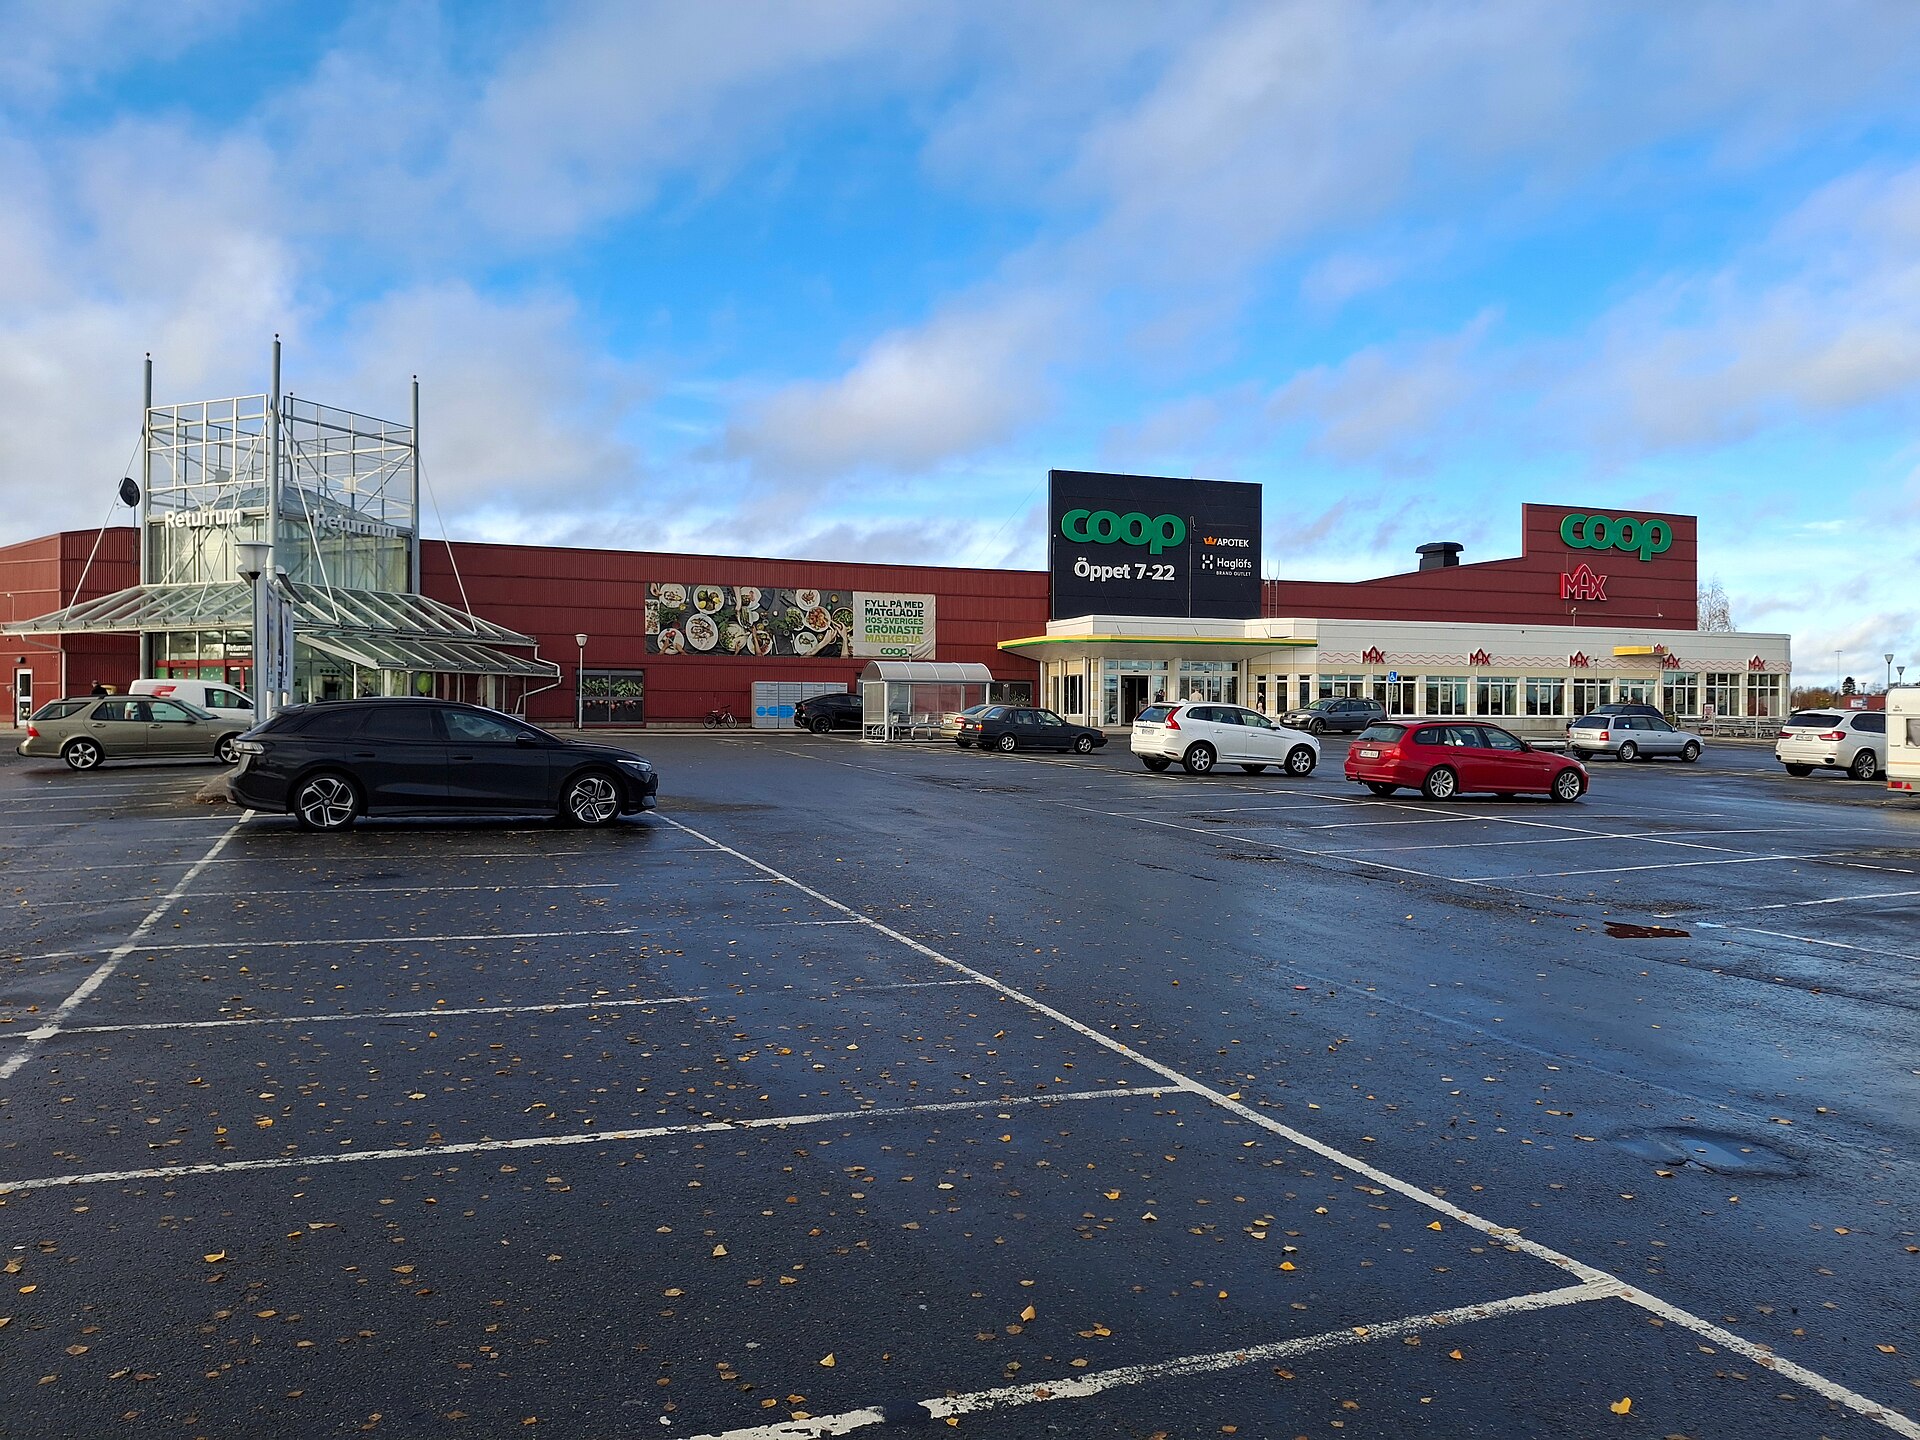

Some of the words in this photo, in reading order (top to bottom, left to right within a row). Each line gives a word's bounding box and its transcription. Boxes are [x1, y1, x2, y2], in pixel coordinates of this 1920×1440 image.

[164, 509, 242, 528] Returrum
[1061, 508, 1186, 555] coop
[1560, 513, 1673, 561] coop
[1216, 537, 1250, 548] APOTEK
[1074, 556, 1131, 582] Öppet
[1134, 563, 1175, 581] 7-22
[1217, 557, 1252, 570] Haglöfs
[1560, 563, 1608, 601] MAX
[865, 600, 888, 608] FYLL
[890, 599, 902, 608] PÅ
[865, 608, 924, 618] MATGLÄDJE
[883, 617, 924, 625] SVERIGES
[865, 624, 924, 635] GRÖNASTE
[880, 647, 908, 657] coop
[1361, 645, 1386, 664] MAX
[1468, 648, 1492, 666] MAX
[1568, 650, 1590, 668] MAX
[1662, 652, 1681, 670] MAX
[1746, 654, 1766, 671] MAX
